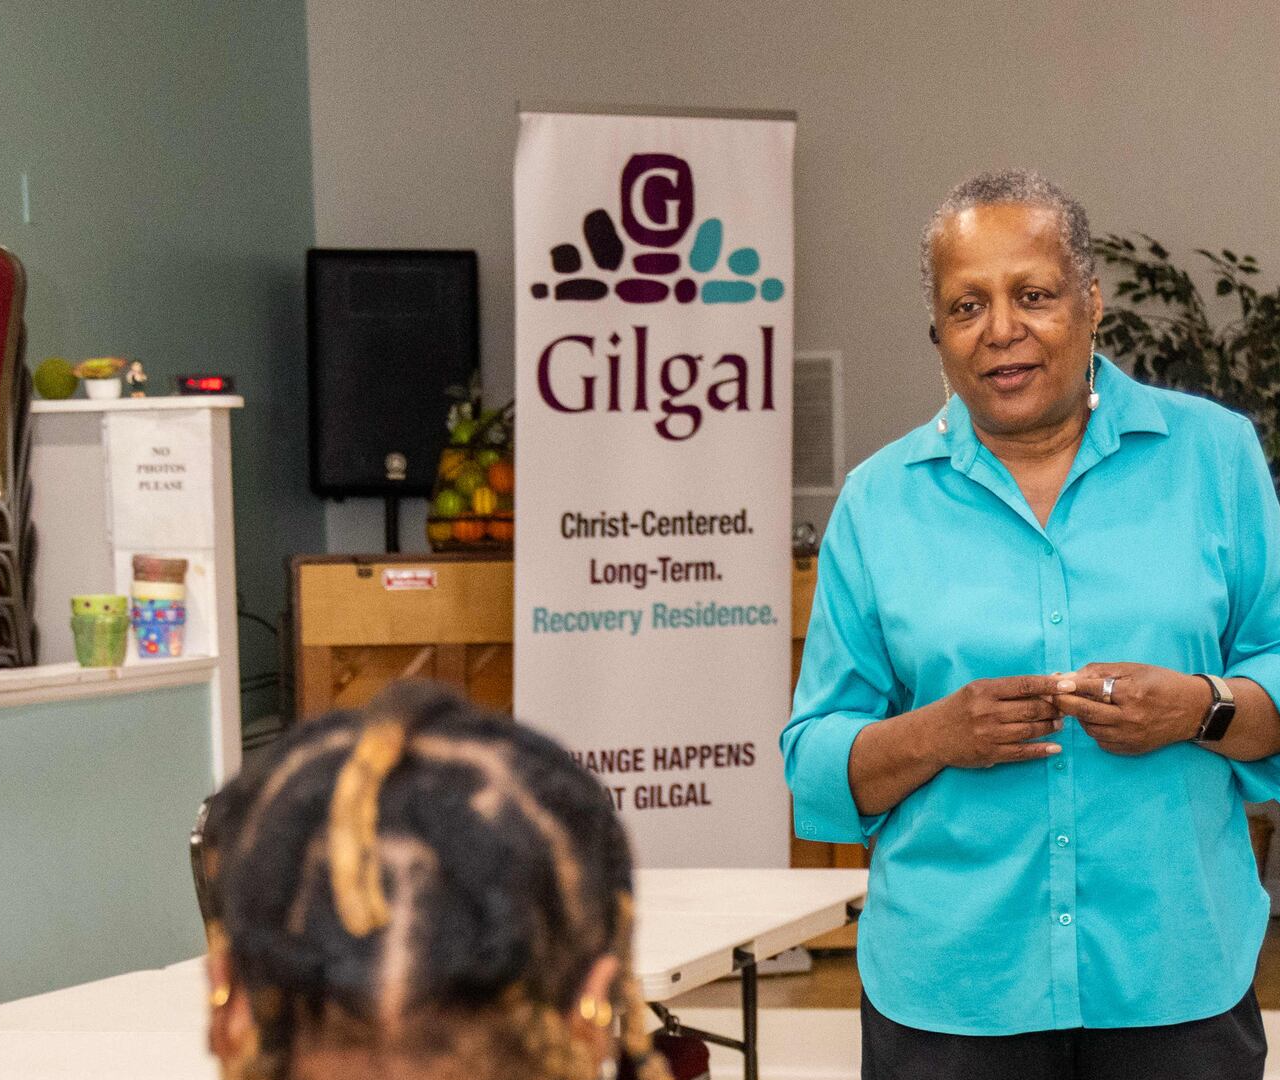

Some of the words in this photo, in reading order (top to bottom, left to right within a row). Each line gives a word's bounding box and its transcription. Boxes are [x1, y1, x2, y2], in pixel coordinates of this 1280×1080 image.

[629, 167, 681, 232] G
[536, 325, 775, 441] Gilgal
[151, 446, 171, 457] NO
[136, 463, 186, 474] PHOTOS
[138, 480, 184, 491] PLEASE
[560, 509, 754, 540] Christ-Centered.
[589, 556, 723, 590] Long-Term.
[531, 606, 643, 636] Recovery
[651, 601, 778, 629] Residence.
[571, 749, 644, 774] HANGE
[652, 742, 756, 771] HAPPENS
[634, 782, 712, 810] GILGAL
